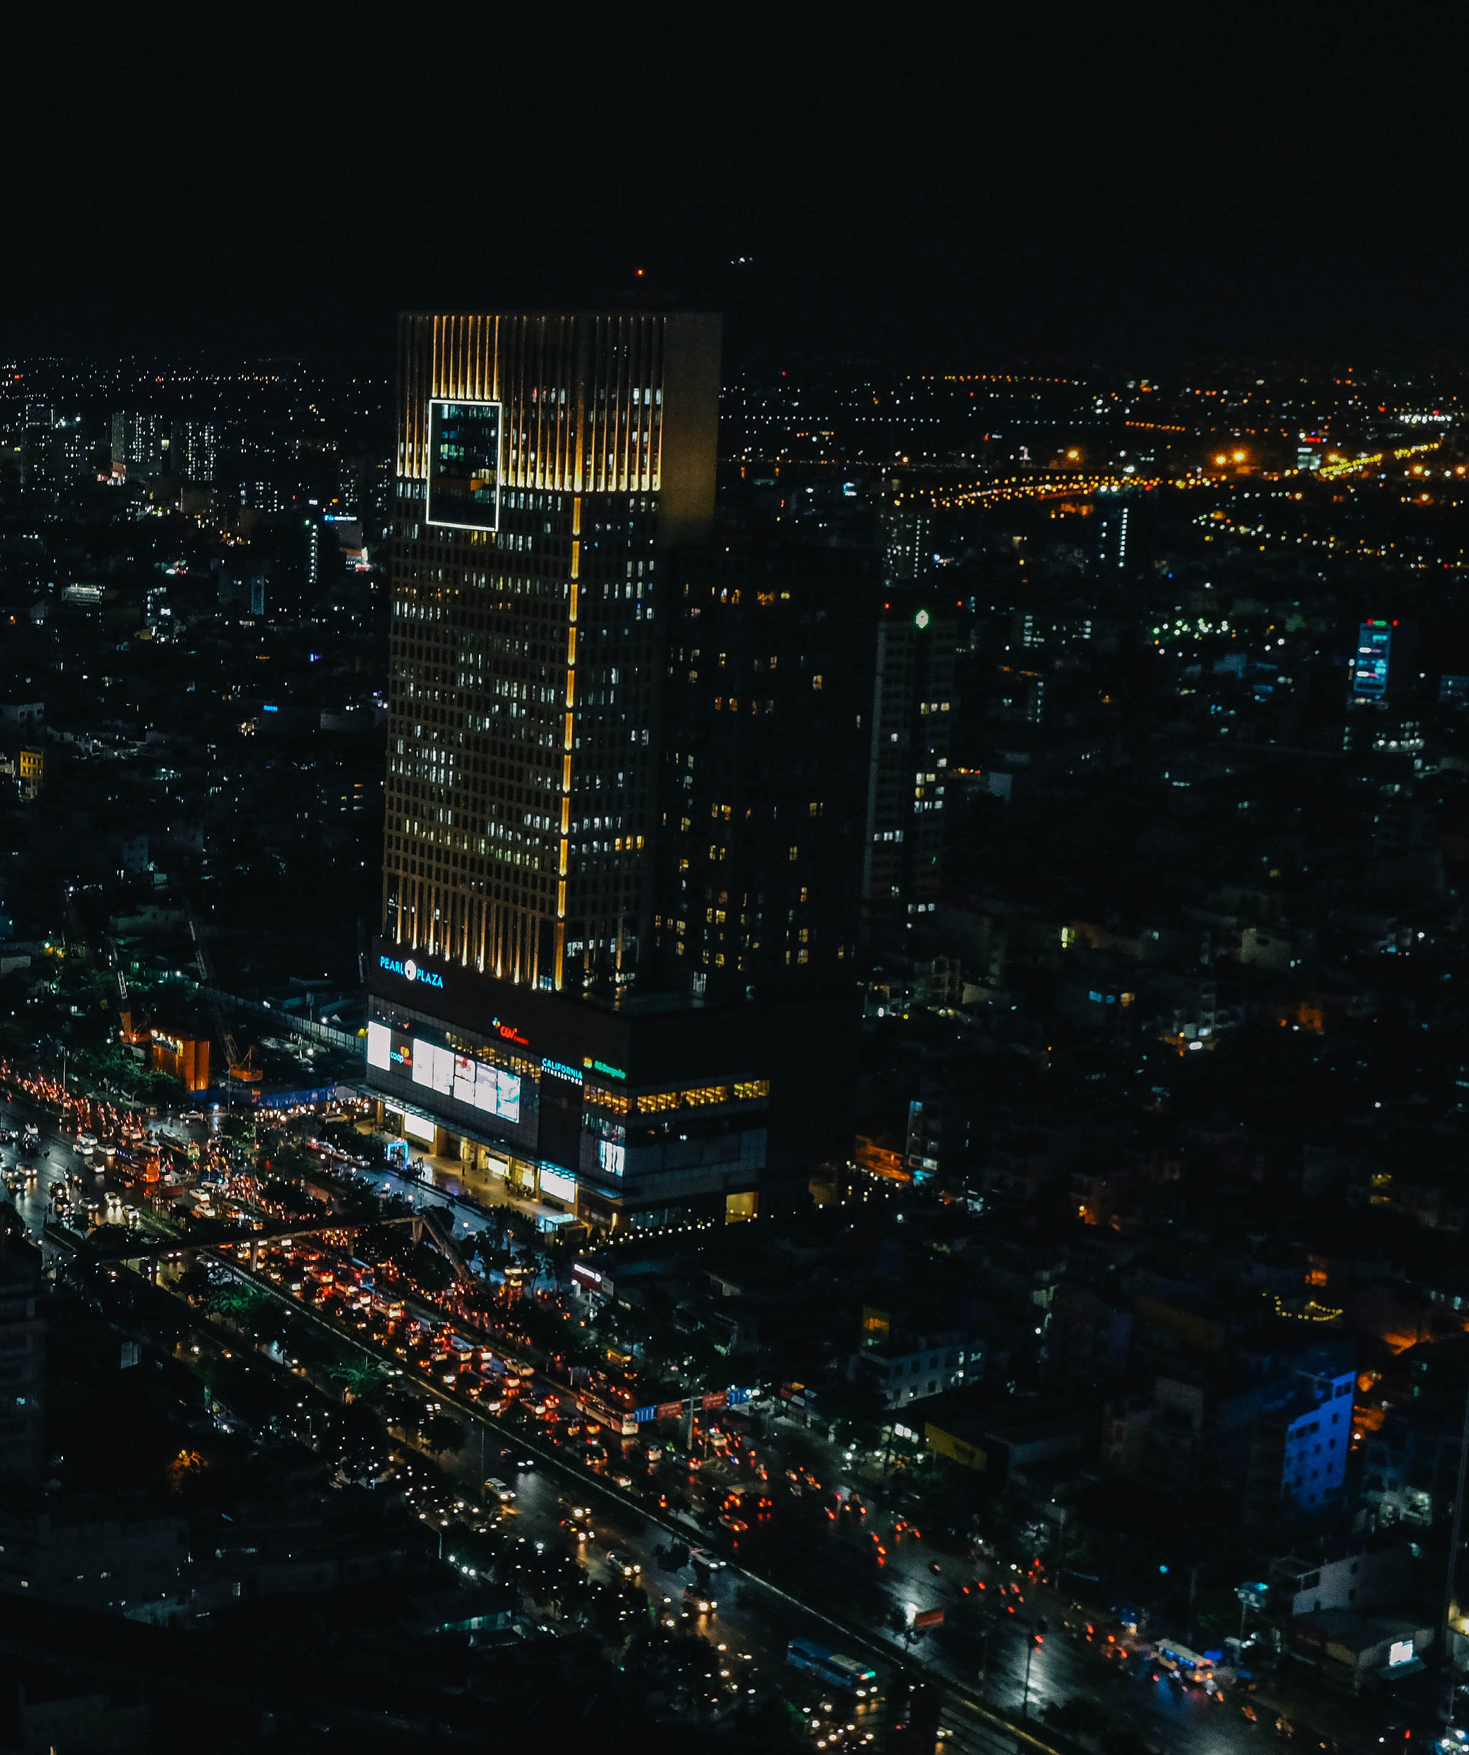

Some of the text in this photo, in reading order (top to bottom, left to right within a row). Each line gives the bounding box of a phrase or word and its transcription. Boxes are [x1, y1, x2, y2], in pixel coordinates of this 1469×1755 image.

[380, 955, 444, 989] PEARL PLAZA
[542, 1058, 583, 1080] CALIFORNIA
